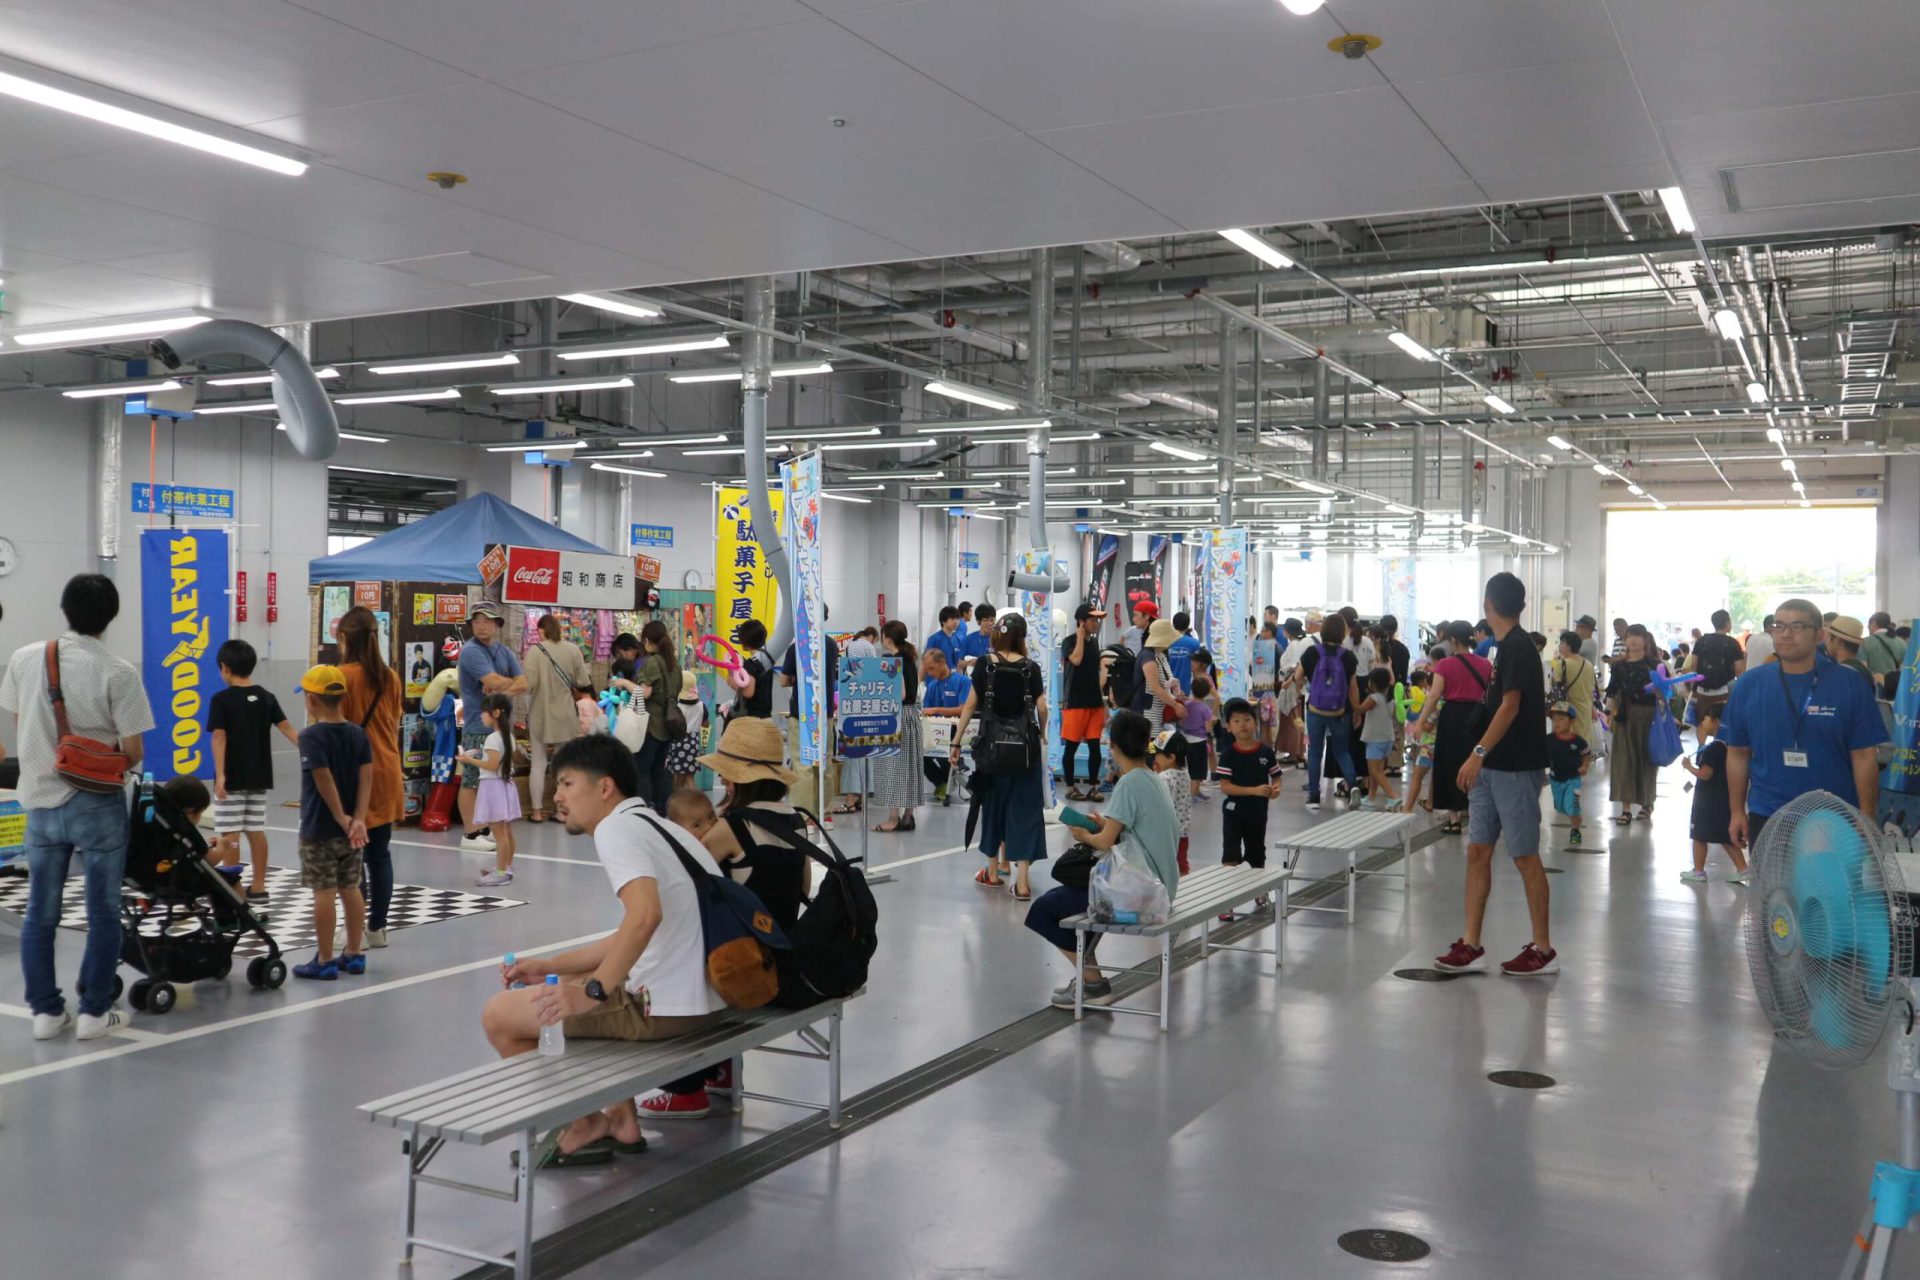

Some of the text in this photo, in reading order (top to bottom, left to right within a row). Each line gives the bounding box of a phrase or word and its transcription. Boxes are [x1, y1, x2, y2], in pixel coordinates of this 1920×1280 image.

[562, 571, 623, 587] 昭和商店
[444, 605, 460, 613] 10円
[848, 681, 894, 696] チャリティ
